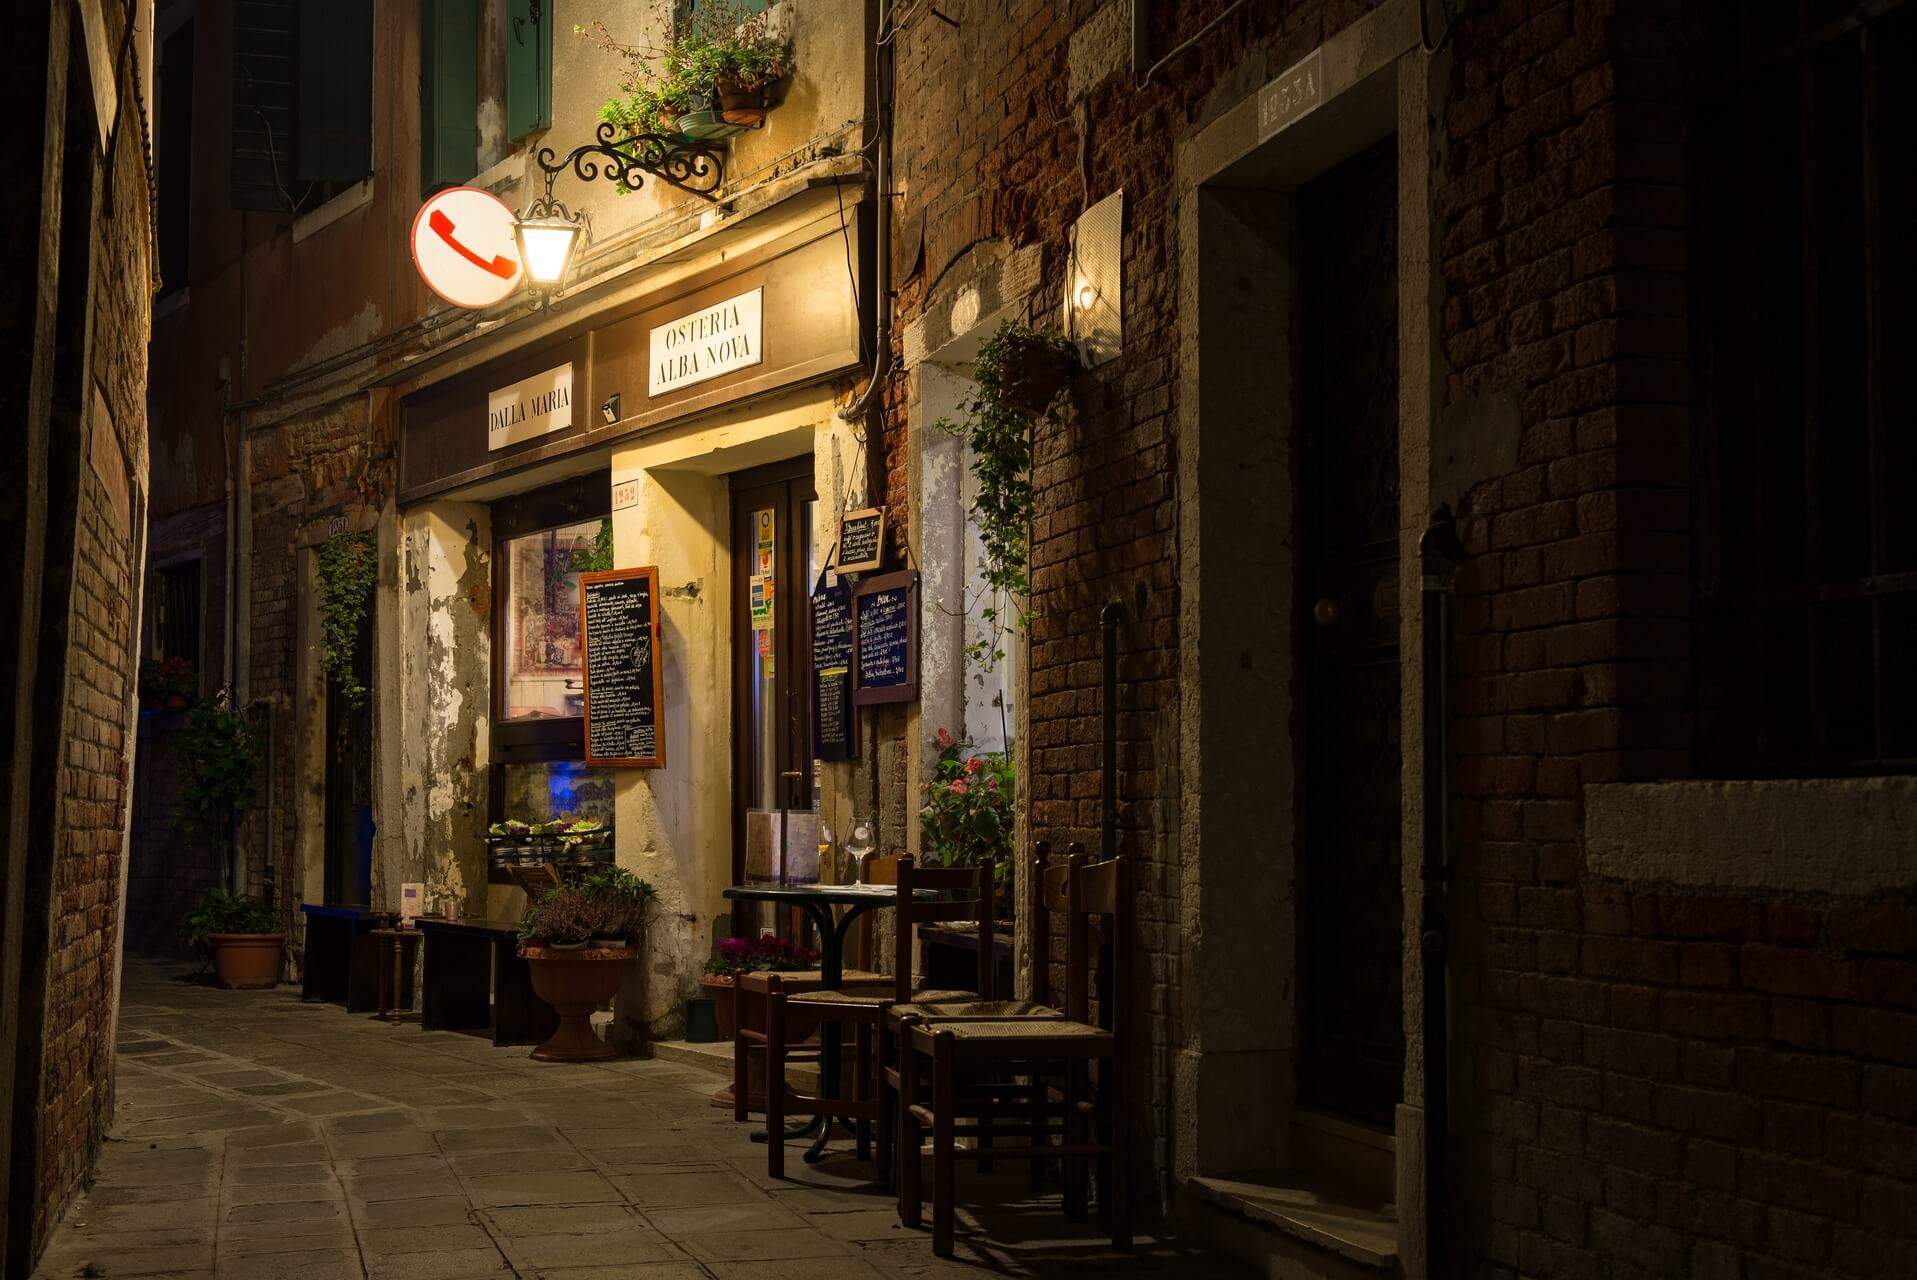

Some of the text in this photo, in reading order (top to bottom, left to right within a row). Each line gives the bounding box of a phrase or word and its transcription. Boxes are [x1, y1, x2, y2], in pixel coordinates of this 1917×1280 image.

[666, 303, 740, 351] OSTERIA
[657, 333, 750, 386] ALBA NOVA
[490, 387, 569, 432] DALLA MARIA
